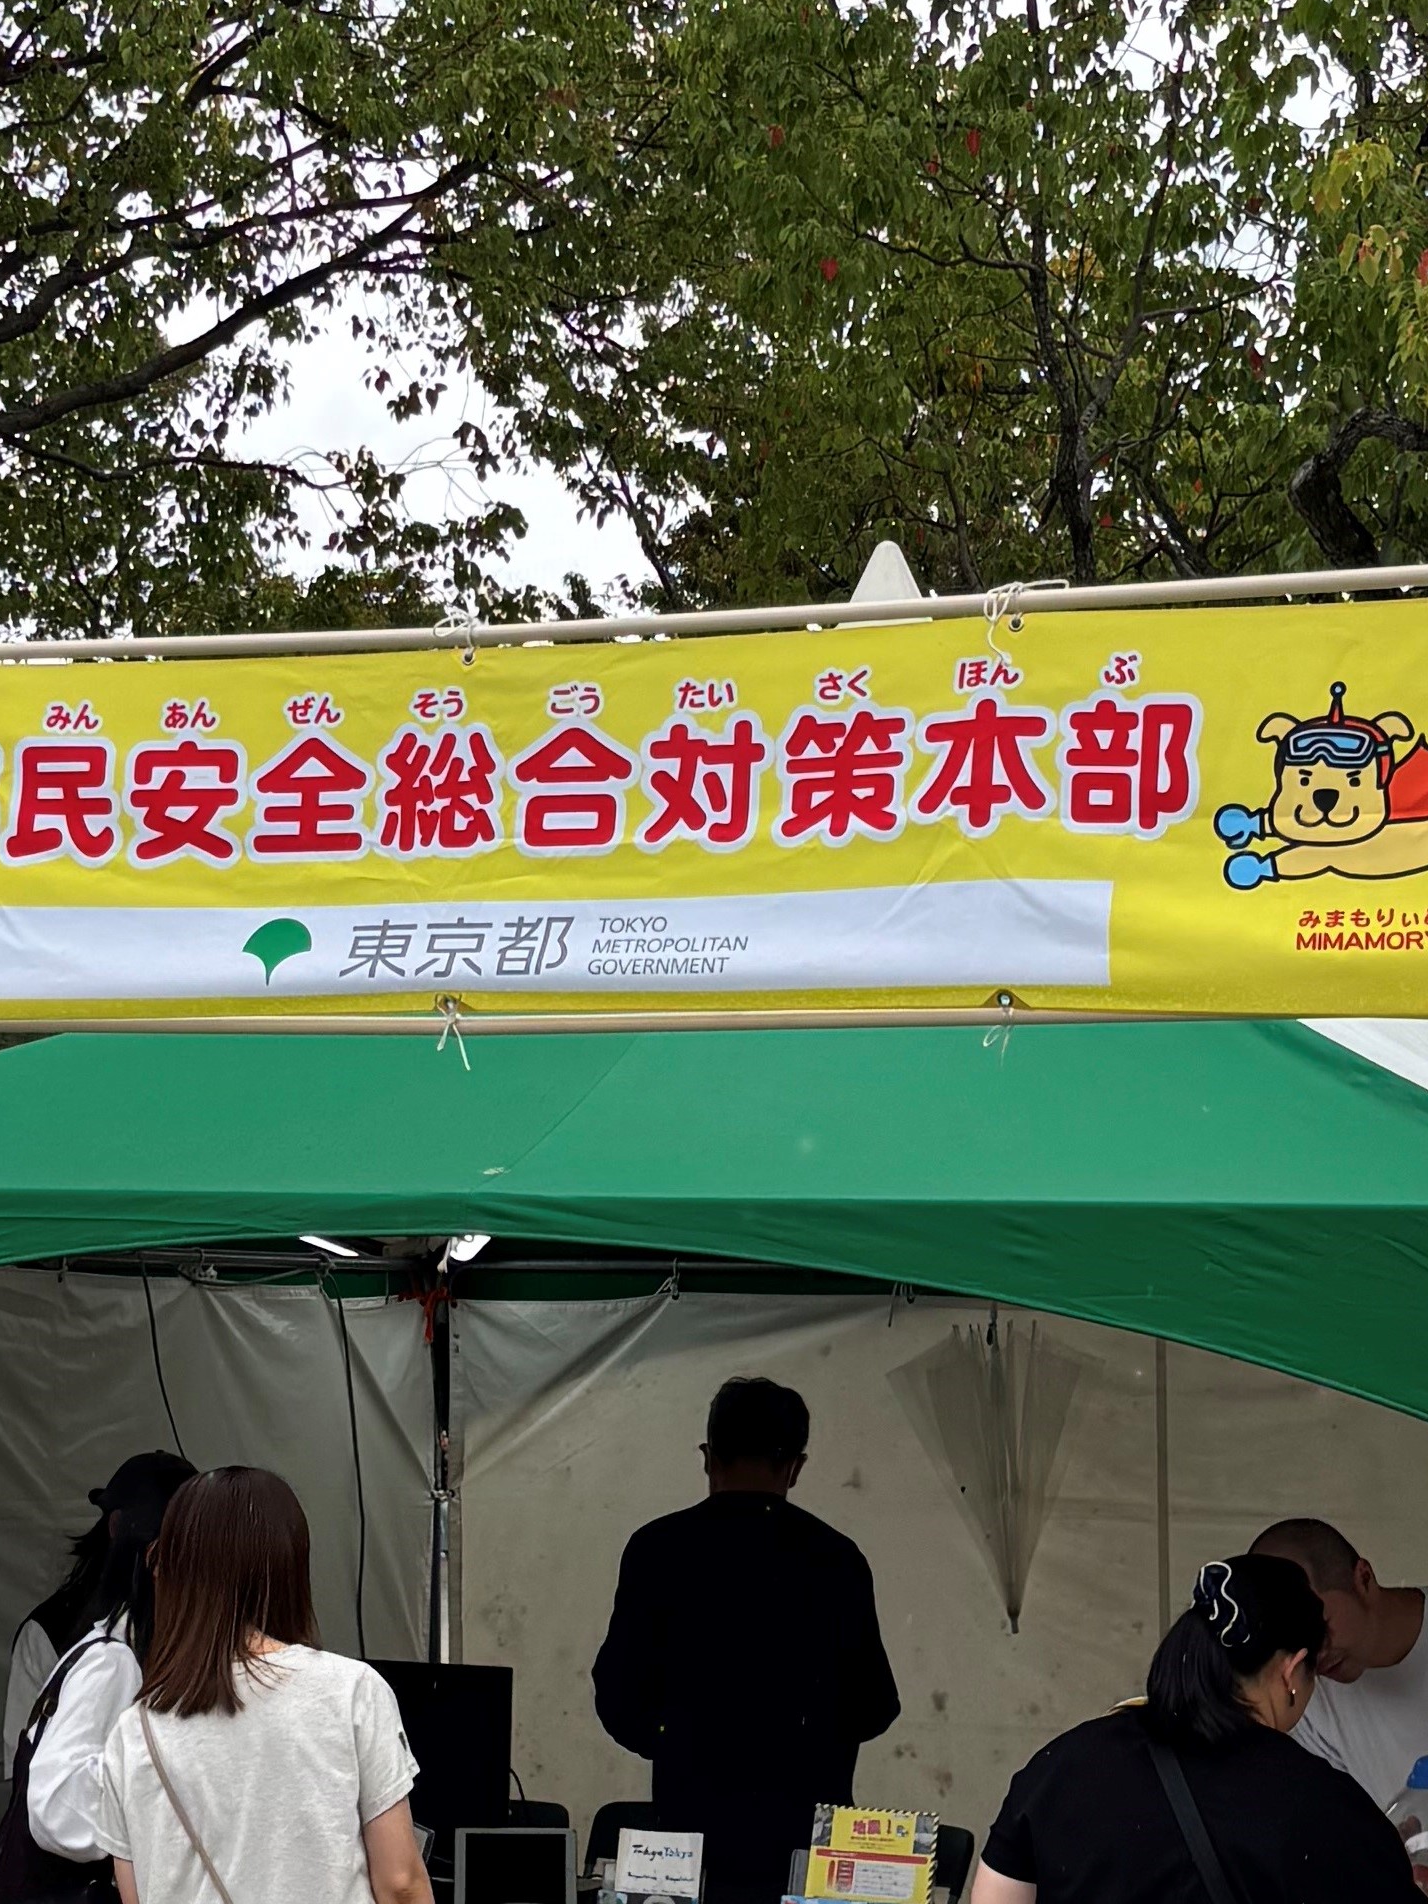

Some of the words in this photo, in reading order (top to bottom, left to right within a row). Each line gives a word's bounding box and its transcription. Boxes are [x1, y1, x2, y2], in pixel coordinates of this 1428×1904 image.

[599, 916, 668, 934] TOKYO
[339, 917, 575, 978] 東京都
[592, 936, 749, 954] METROPOLITAN
[587, 957, 730, 976] GOVERNMENT
